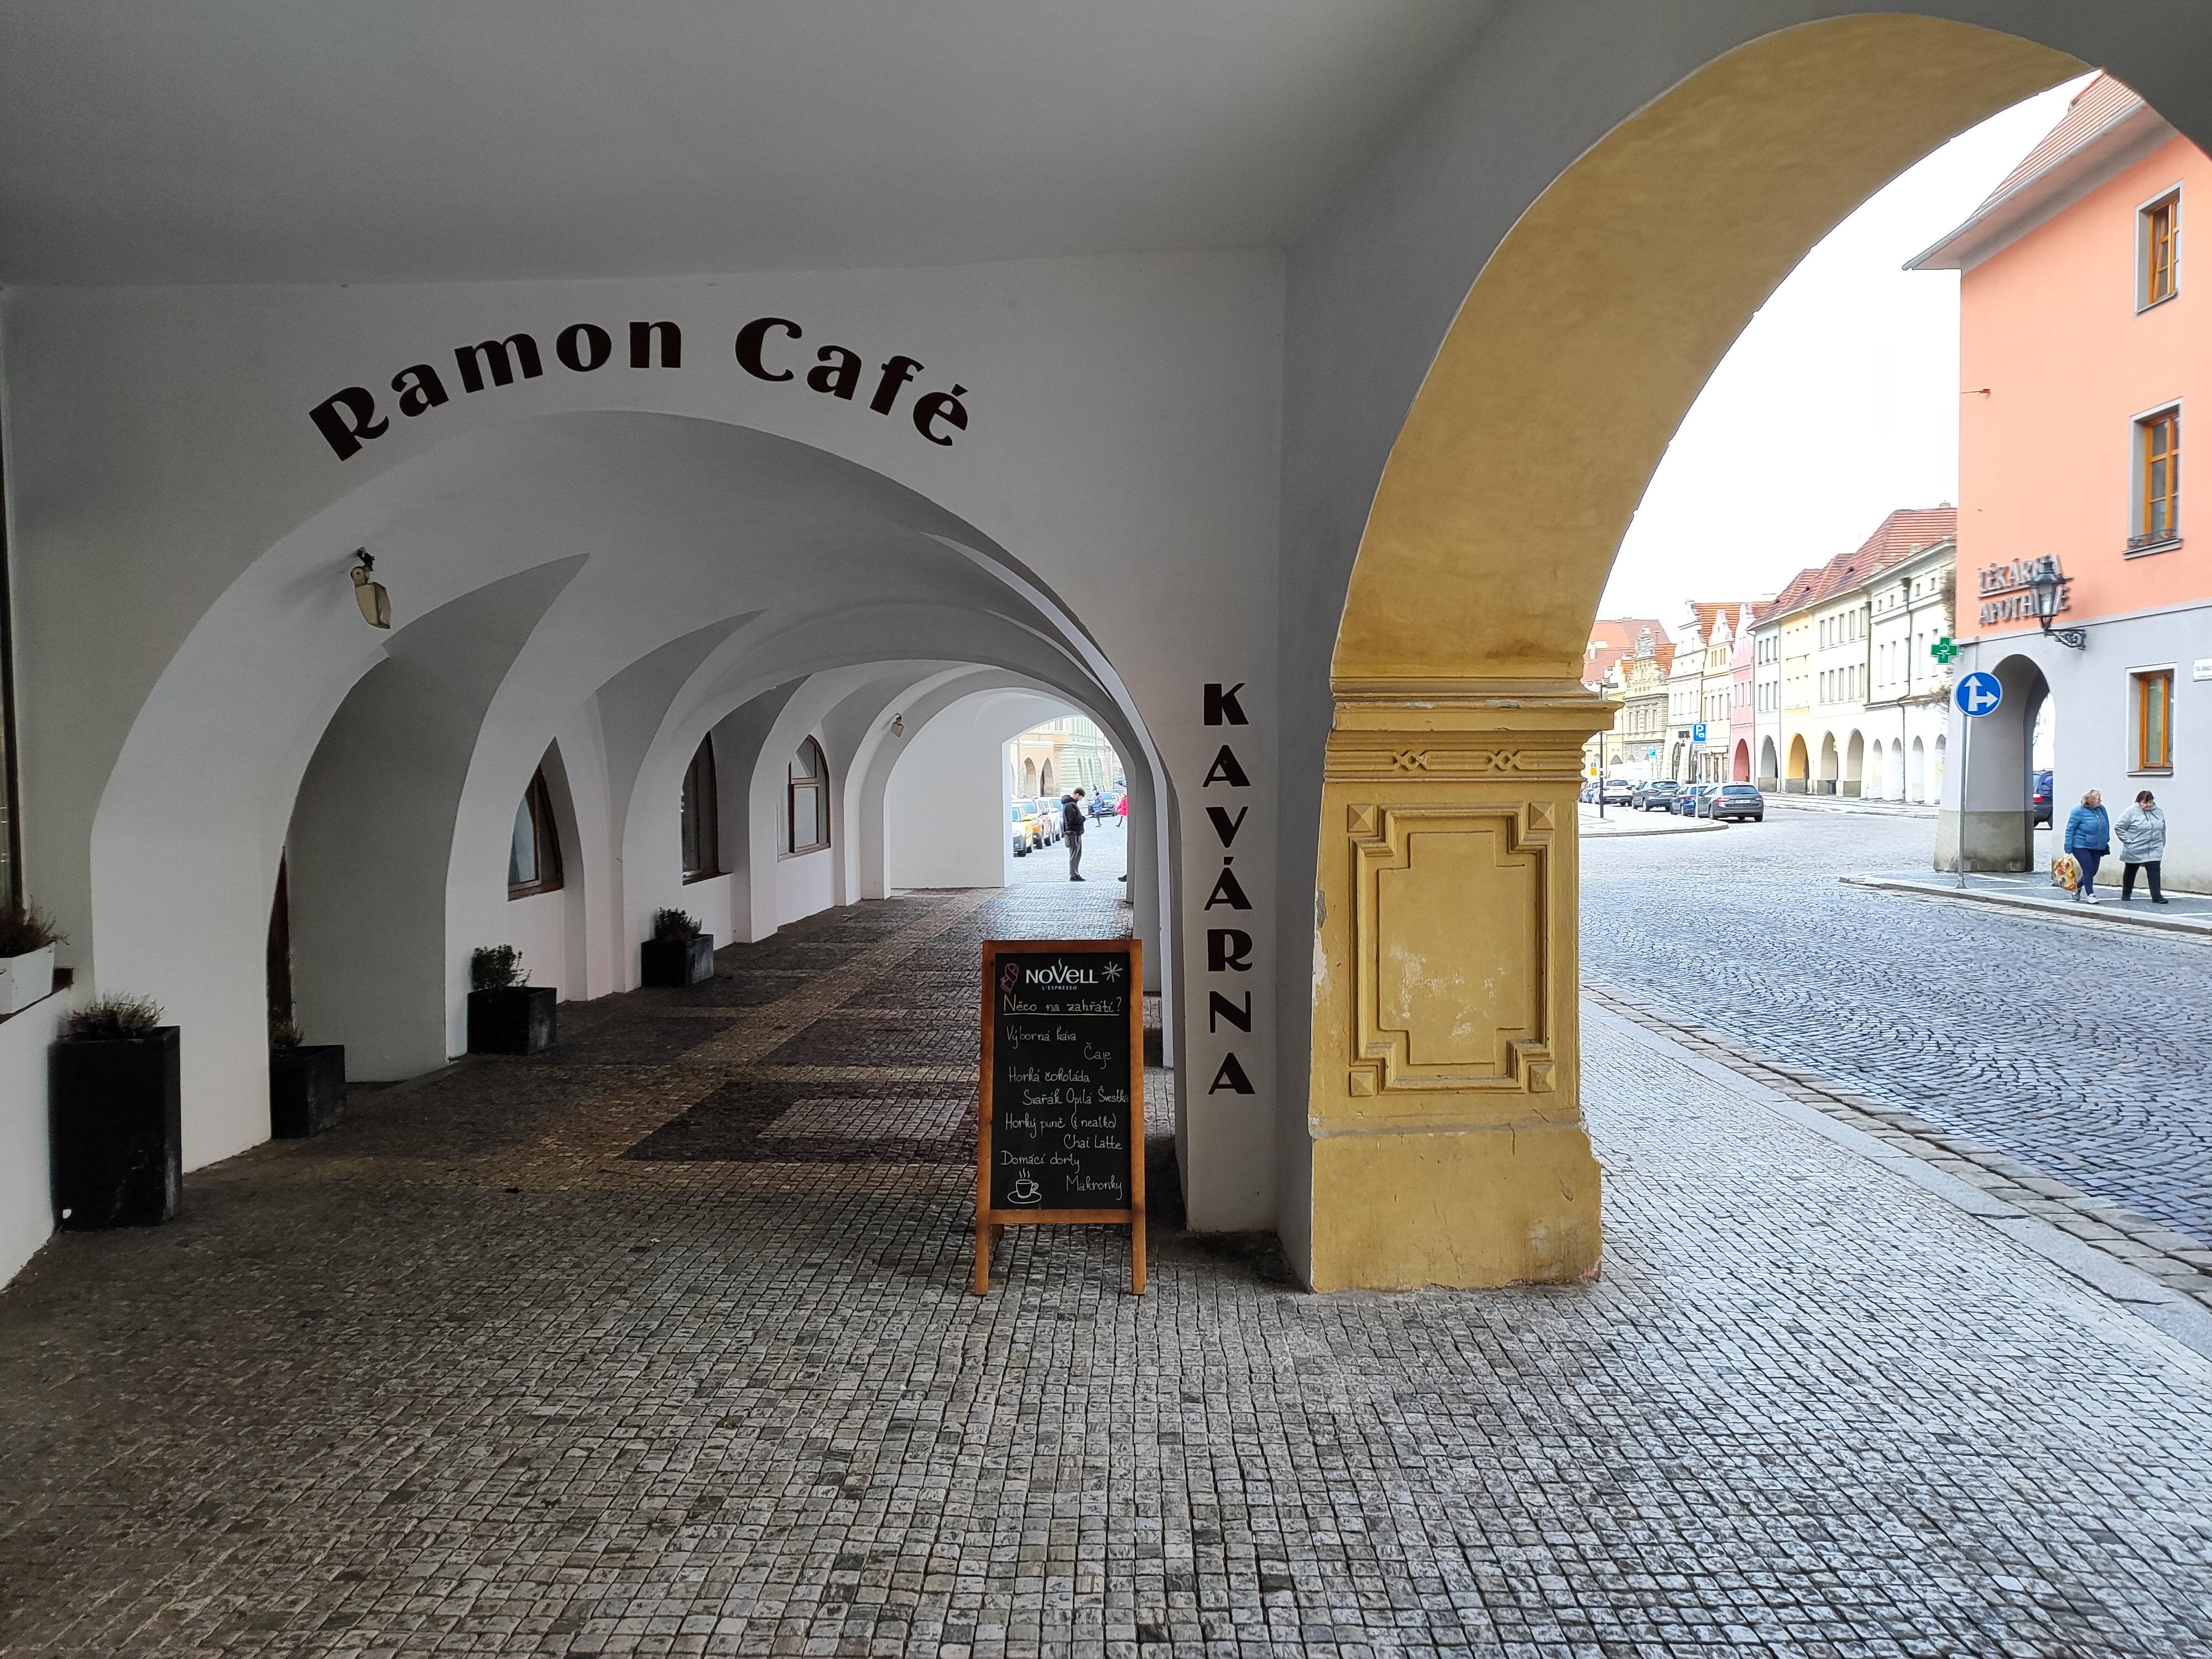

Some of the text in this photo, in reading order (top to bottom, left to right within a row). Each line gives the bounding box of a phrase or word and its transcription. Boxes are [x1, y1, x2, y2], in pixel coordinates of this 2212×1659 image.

[309, 317, 969, 462] Ramon Café
[1978, 584, 2070, 625] APOTHE
[1202, 682, 1256, 1095] KAVÁRNA
[1003, 994, 1037, 1011] Něco
[1066, 997, 1122, 1012] zahřátí?
[1006, 1025, 1077, 1050] Výborná káva
[1083, 1042, 1112, 1070] Čaje
[1009, 1066, 1091, 1083] Horká čokoláda
[1022, 1085, 1129, 1114] Svařák Opilá Švestka
[1005, 1112, 1117, 1139] Horký punč (i nealko)
[1063, 1134, 1123, 1150] Chai Latte
[1000, 1150, 1080, 1174] Domácí dorty
[1066, 1175, 1123, 1201] Makronky
